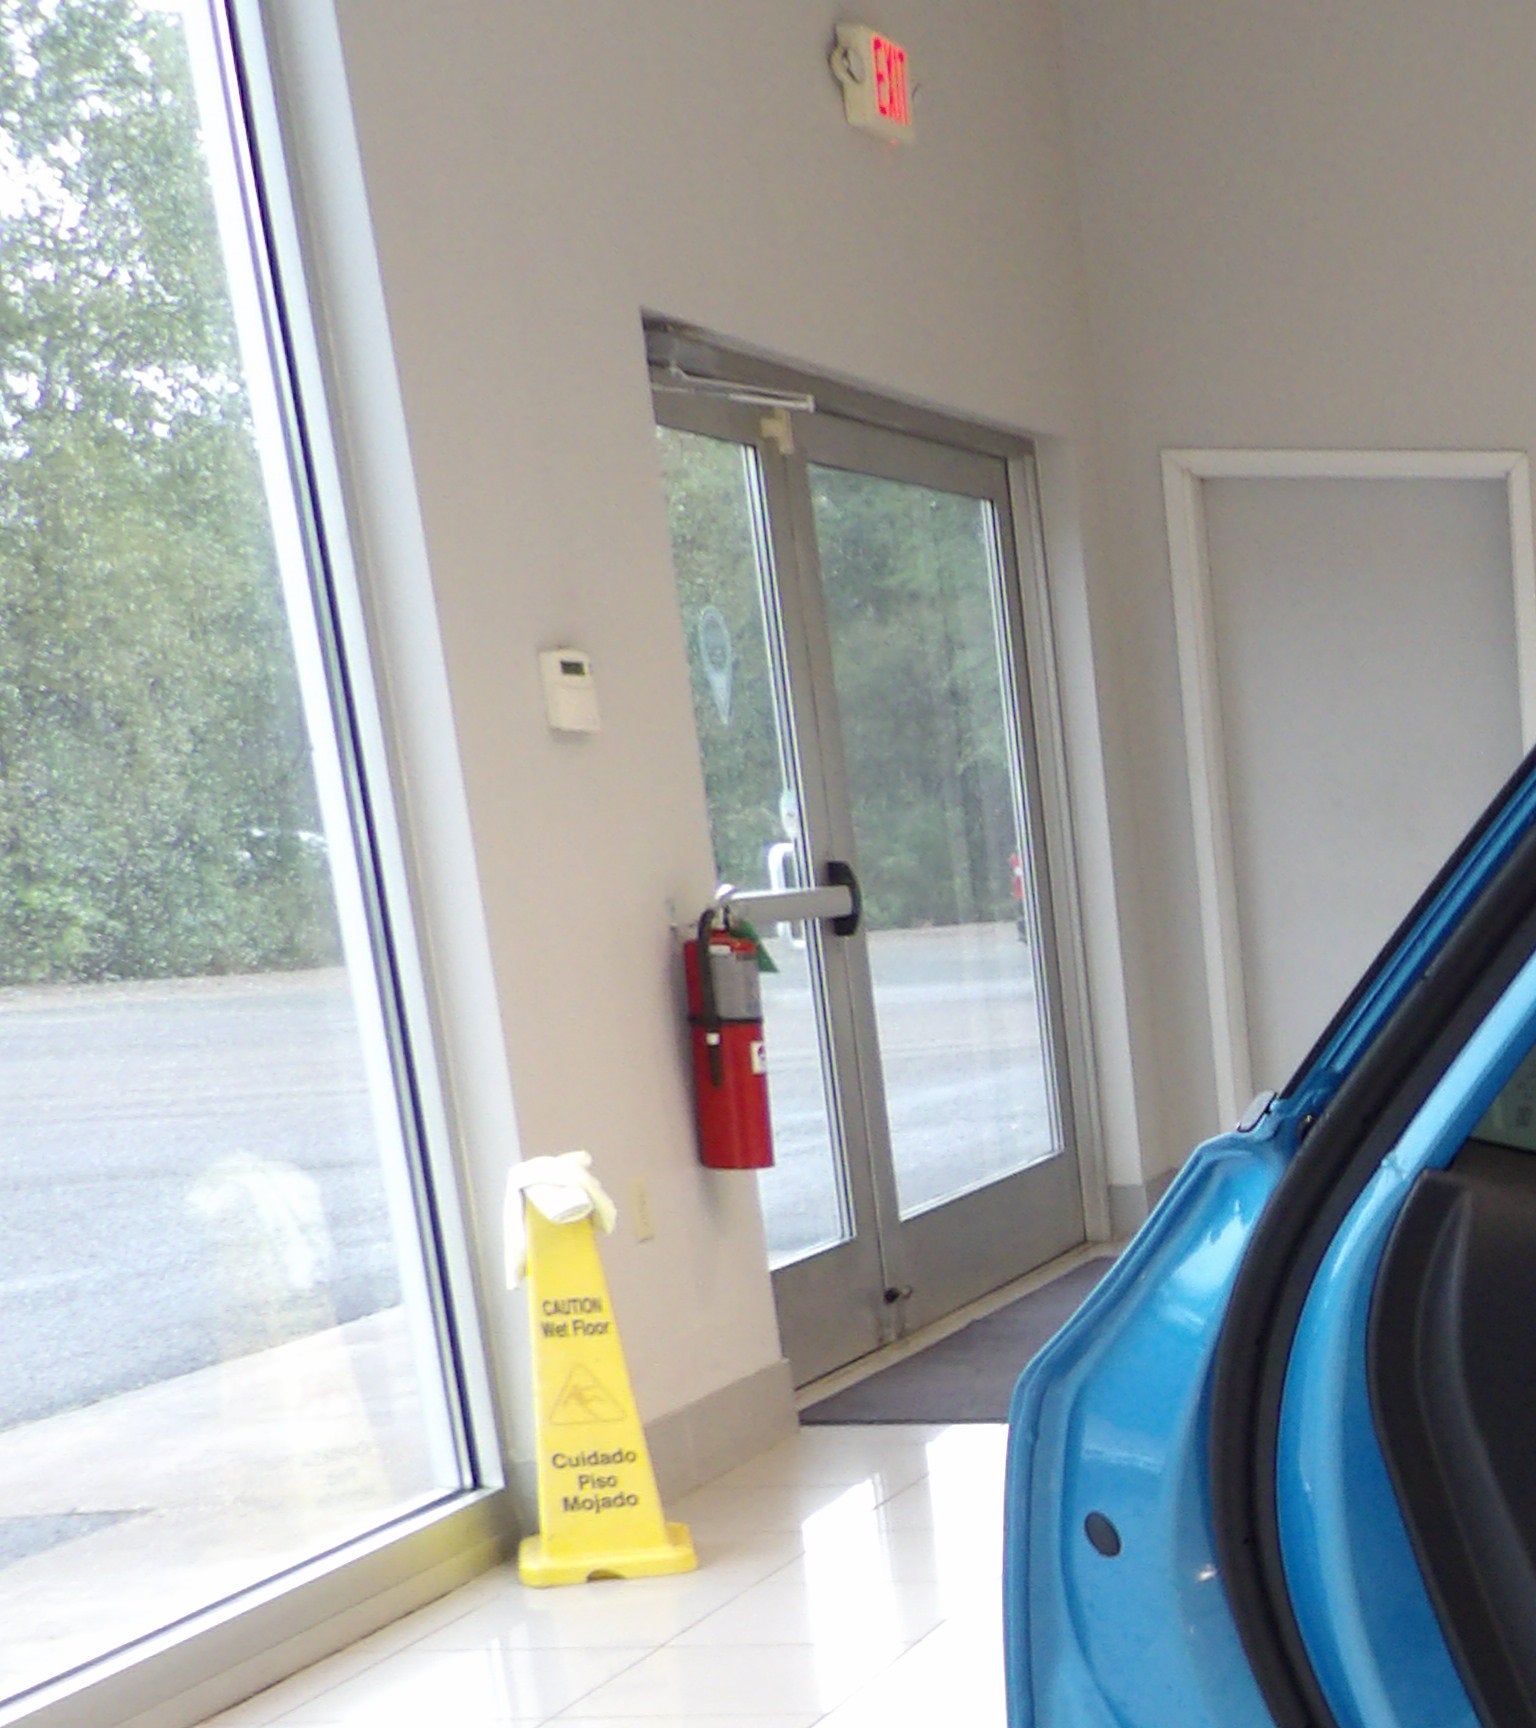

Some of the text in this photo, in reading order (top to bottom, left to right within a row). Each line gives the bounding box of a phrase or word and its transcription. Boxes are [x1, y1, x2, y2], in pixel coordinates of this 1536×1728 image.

[542, 1297, 603, 1316] CAUTION
[541, 1319, 609, 1338] Wet Floor
[552, 1449, 637, 1469] Cuidado
[578, 1474, 618, 1490] Piso
[562, 1492, 639, 1514] Mojado
